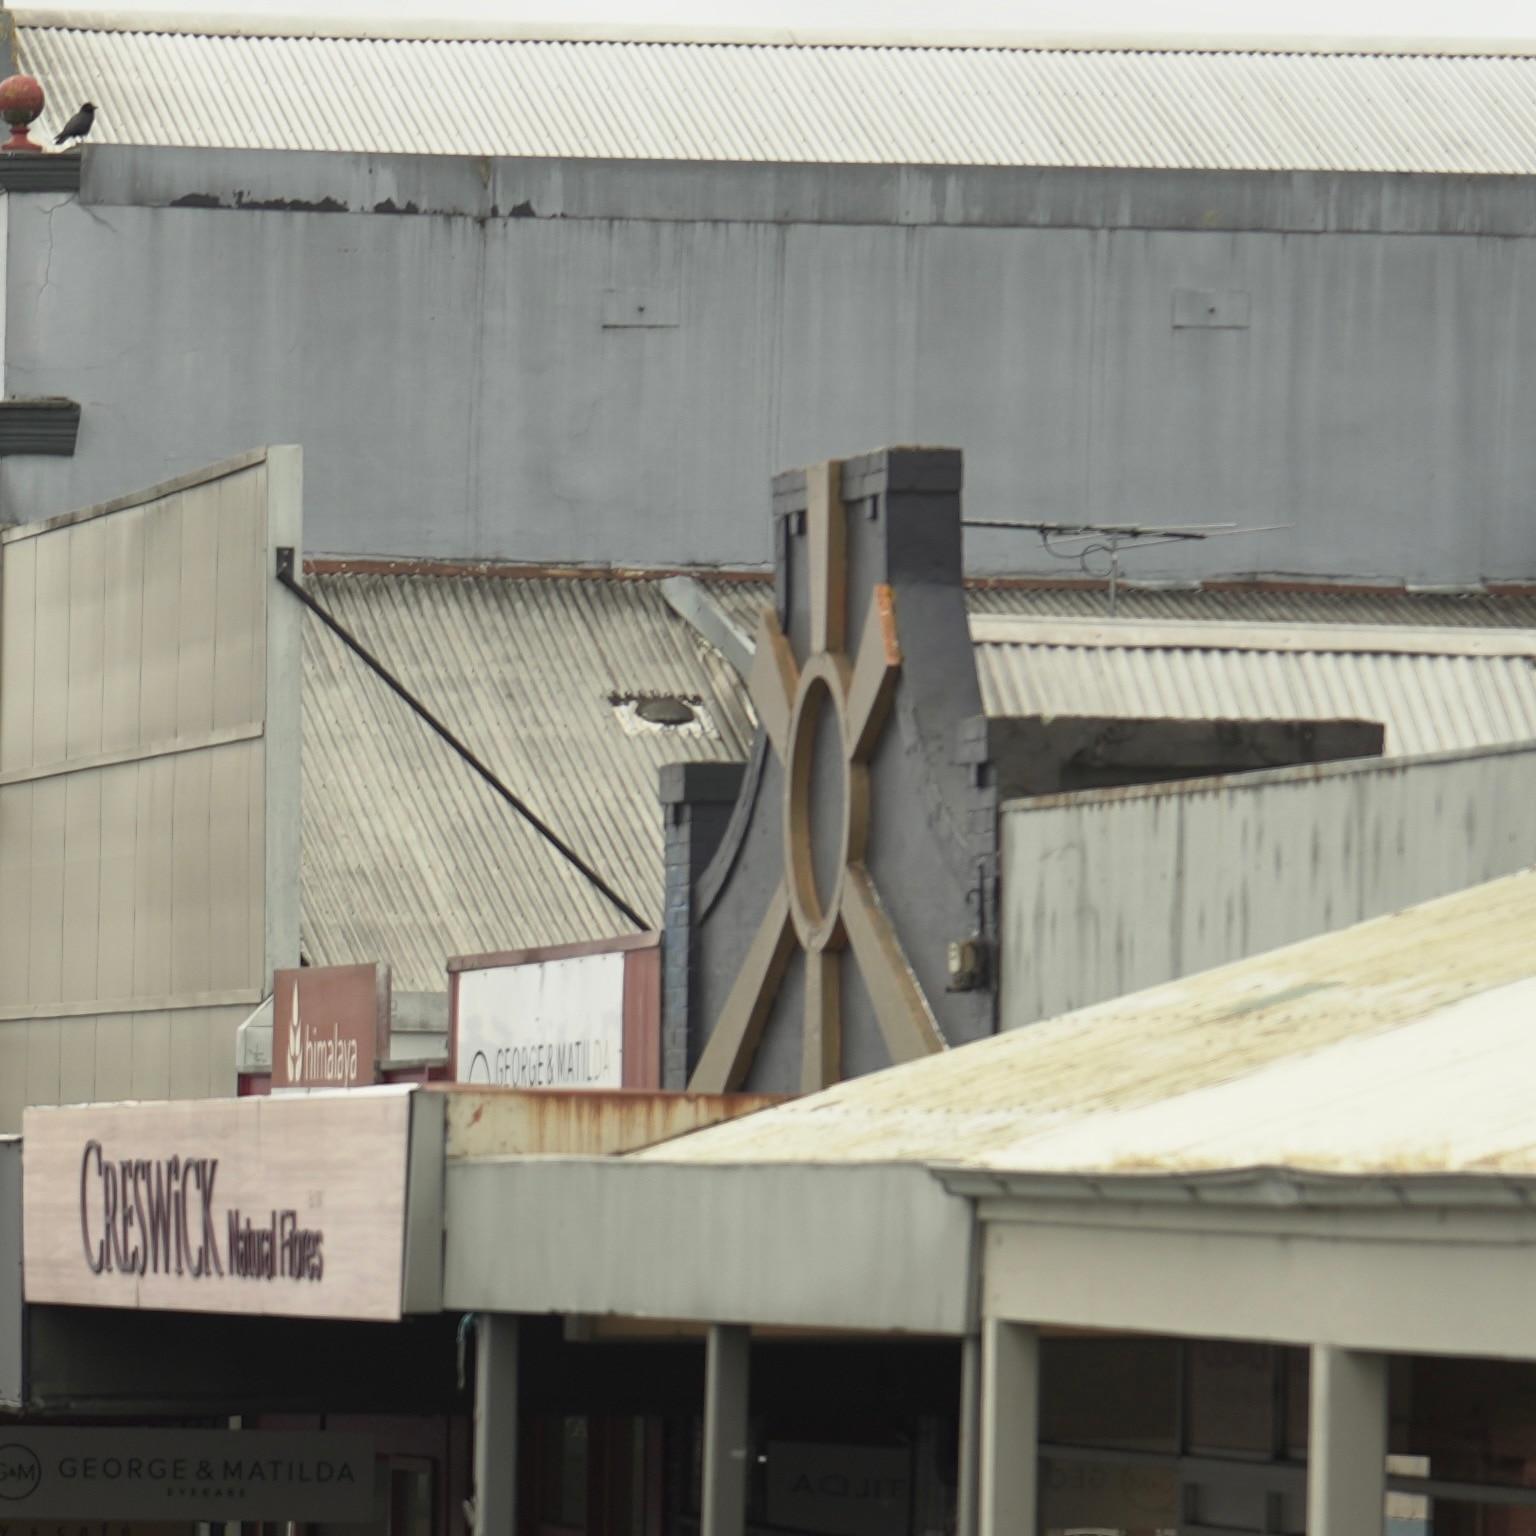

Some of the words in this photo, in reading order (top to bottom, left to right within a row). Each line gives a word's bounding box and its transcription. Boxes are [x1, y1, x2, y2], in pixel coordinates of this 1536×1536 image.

[305, 1022, 358, 1087] himalaya
[495, 1045, 544, 1087] GEORGE
[556, 1039, 613, 1081] MATILDA
[58, 1456, 186, 1481] GEORGE
[195, 1460, 215, 1482] &
[223, 1459, 356, 1484] MATILDA
